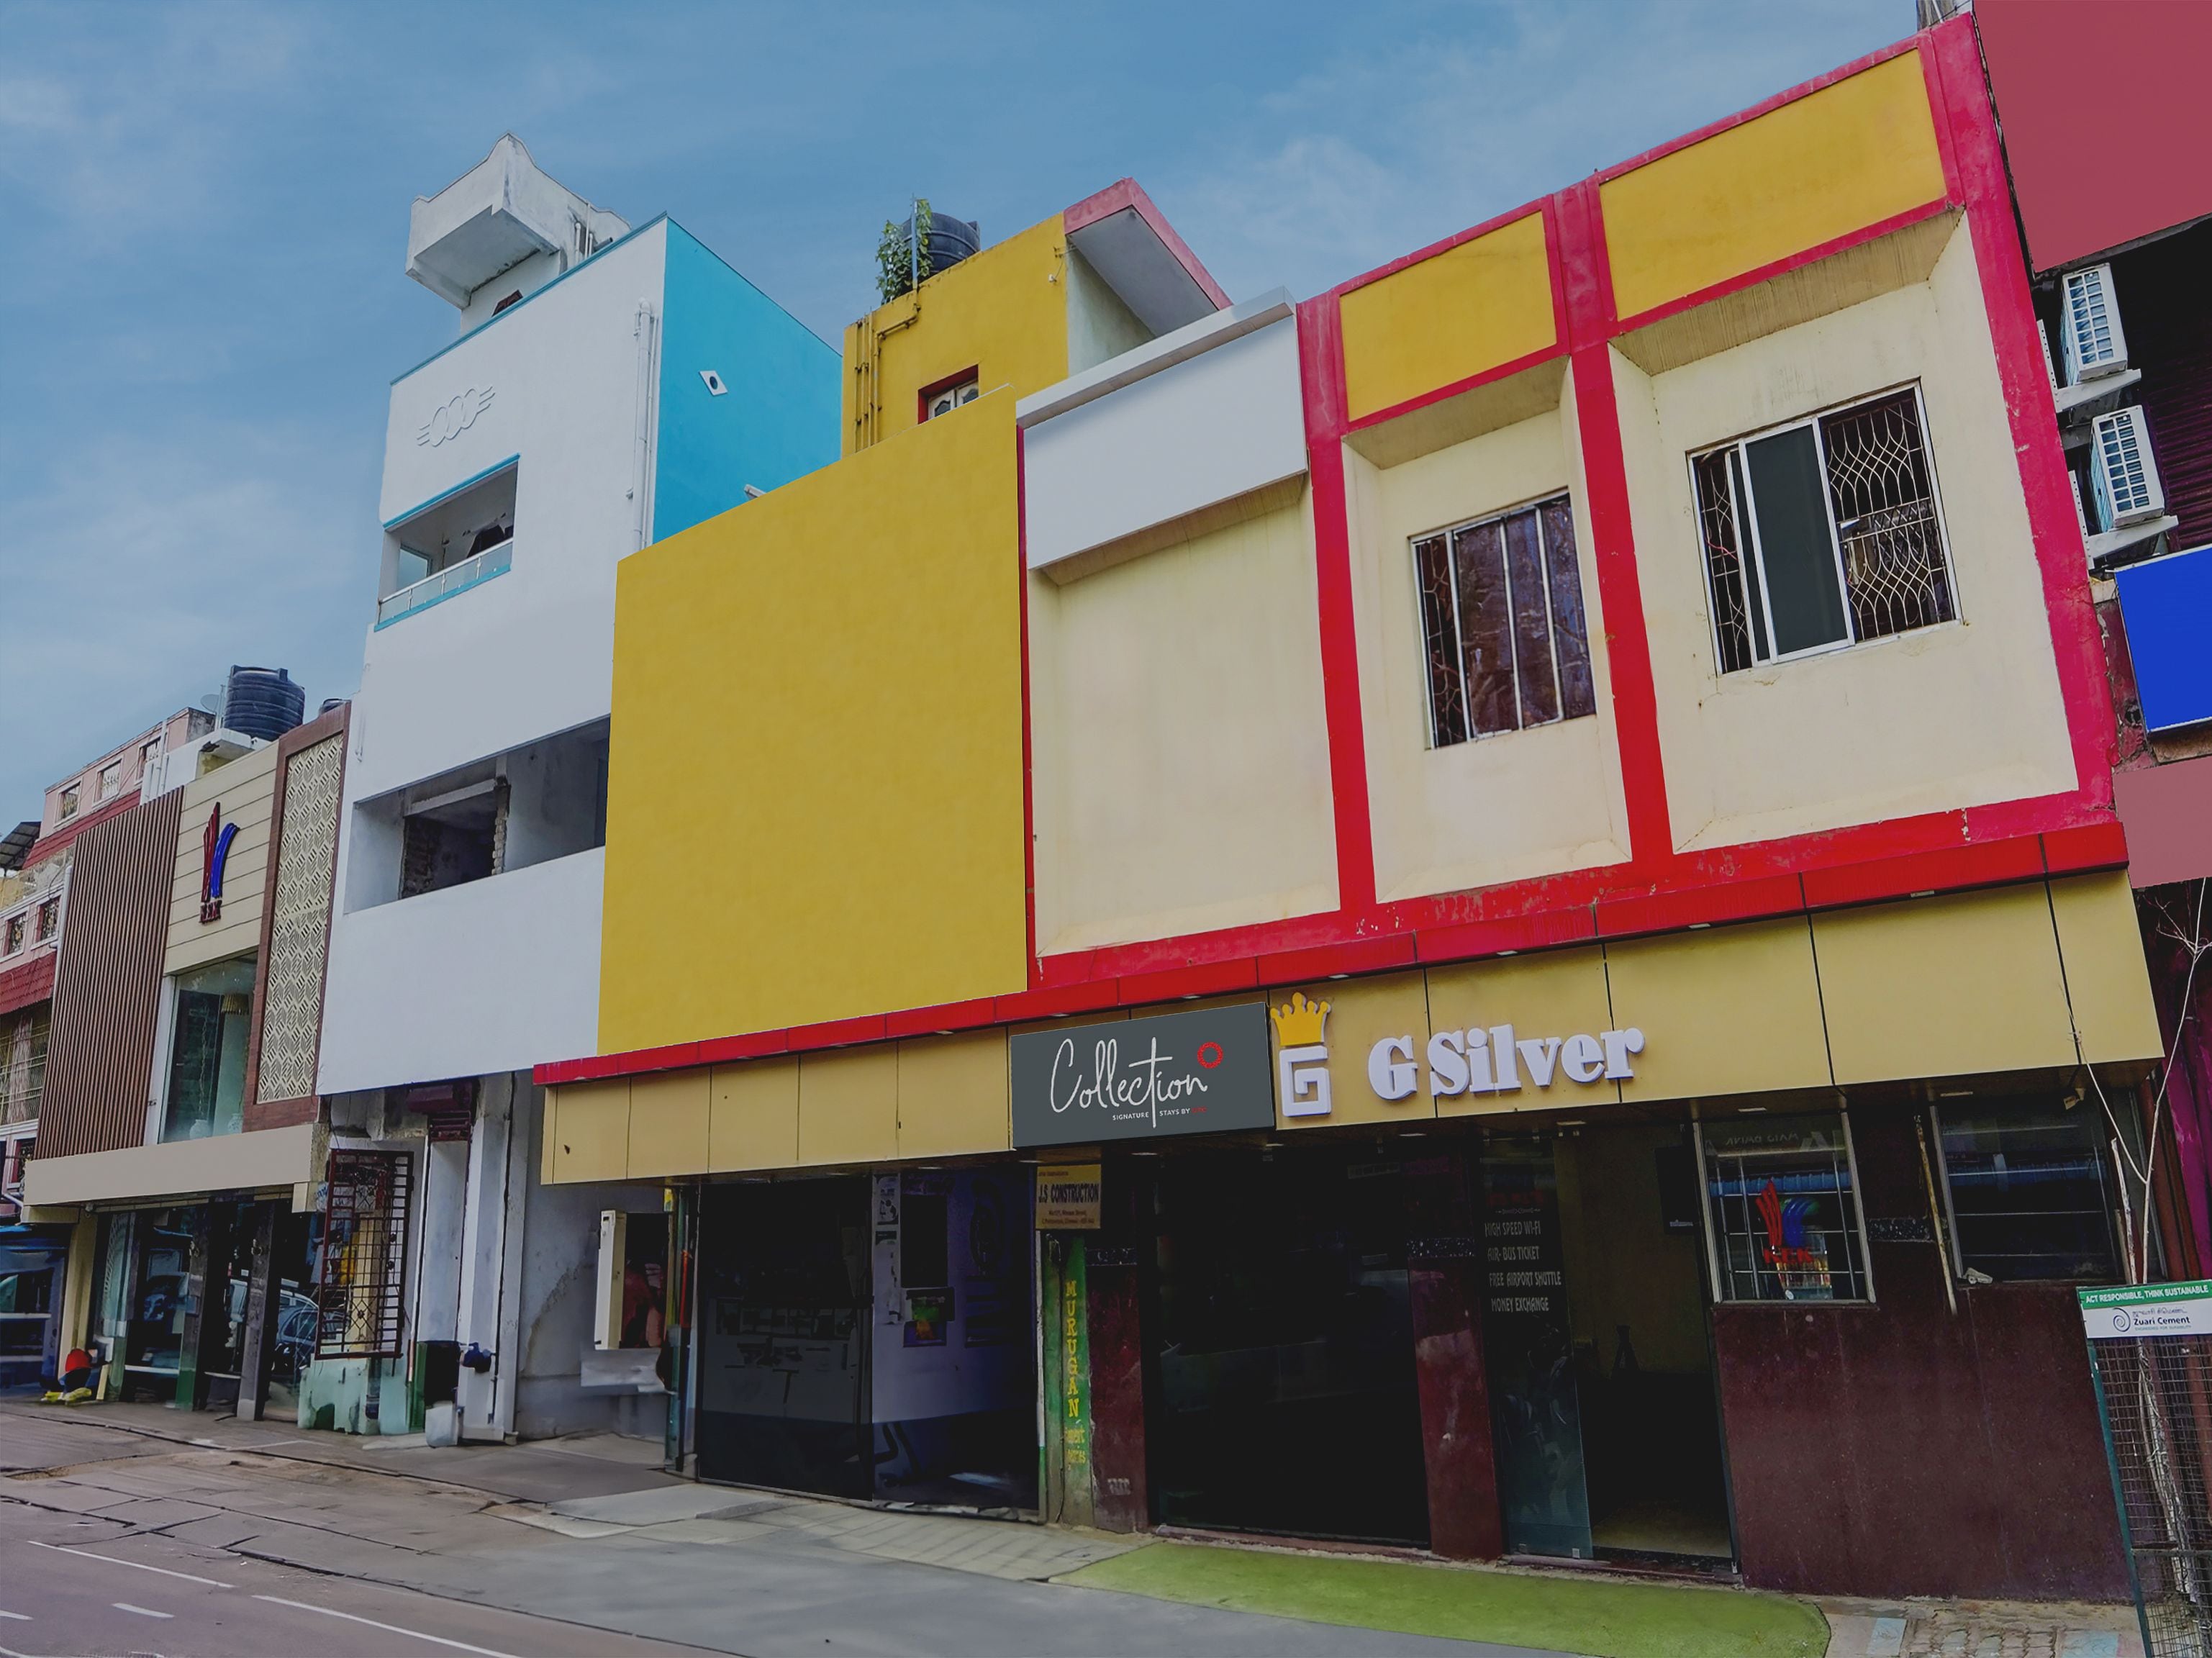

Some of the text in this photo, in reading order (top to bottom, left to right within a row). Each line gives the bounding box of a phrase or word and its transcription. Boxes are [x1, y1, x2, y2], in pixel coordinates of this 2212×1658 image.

[1368, 1023, 1646, 1100] G Silver
[1050, 1037, 1208, 1128] Collection
[1112, 1112, 1149, 1120] SIGNATURE
[1051, 1183, 1099, 1203] CONSTRUCTION
[1485, 1220, 1541, 1237] HIGH SPEED WI-FI
[1502, 1246, 1515, 1260] BUS
[1517, 1246, 1539, 1259] TICKET
[1489, 1271, 1561, 1287] FREE AIRPORT SHUTTLE
[2086, 1285, 2209, 1303] ACT RESPONSIBLE, THINK SUSTAINABLE
[1491, 1297, 1549, 1313] MONEY EXCHANGE
[2134, 1316, 2190, 1326] Zuari Cement
[1065, 1281, 1079, 1418] MURUGAN
